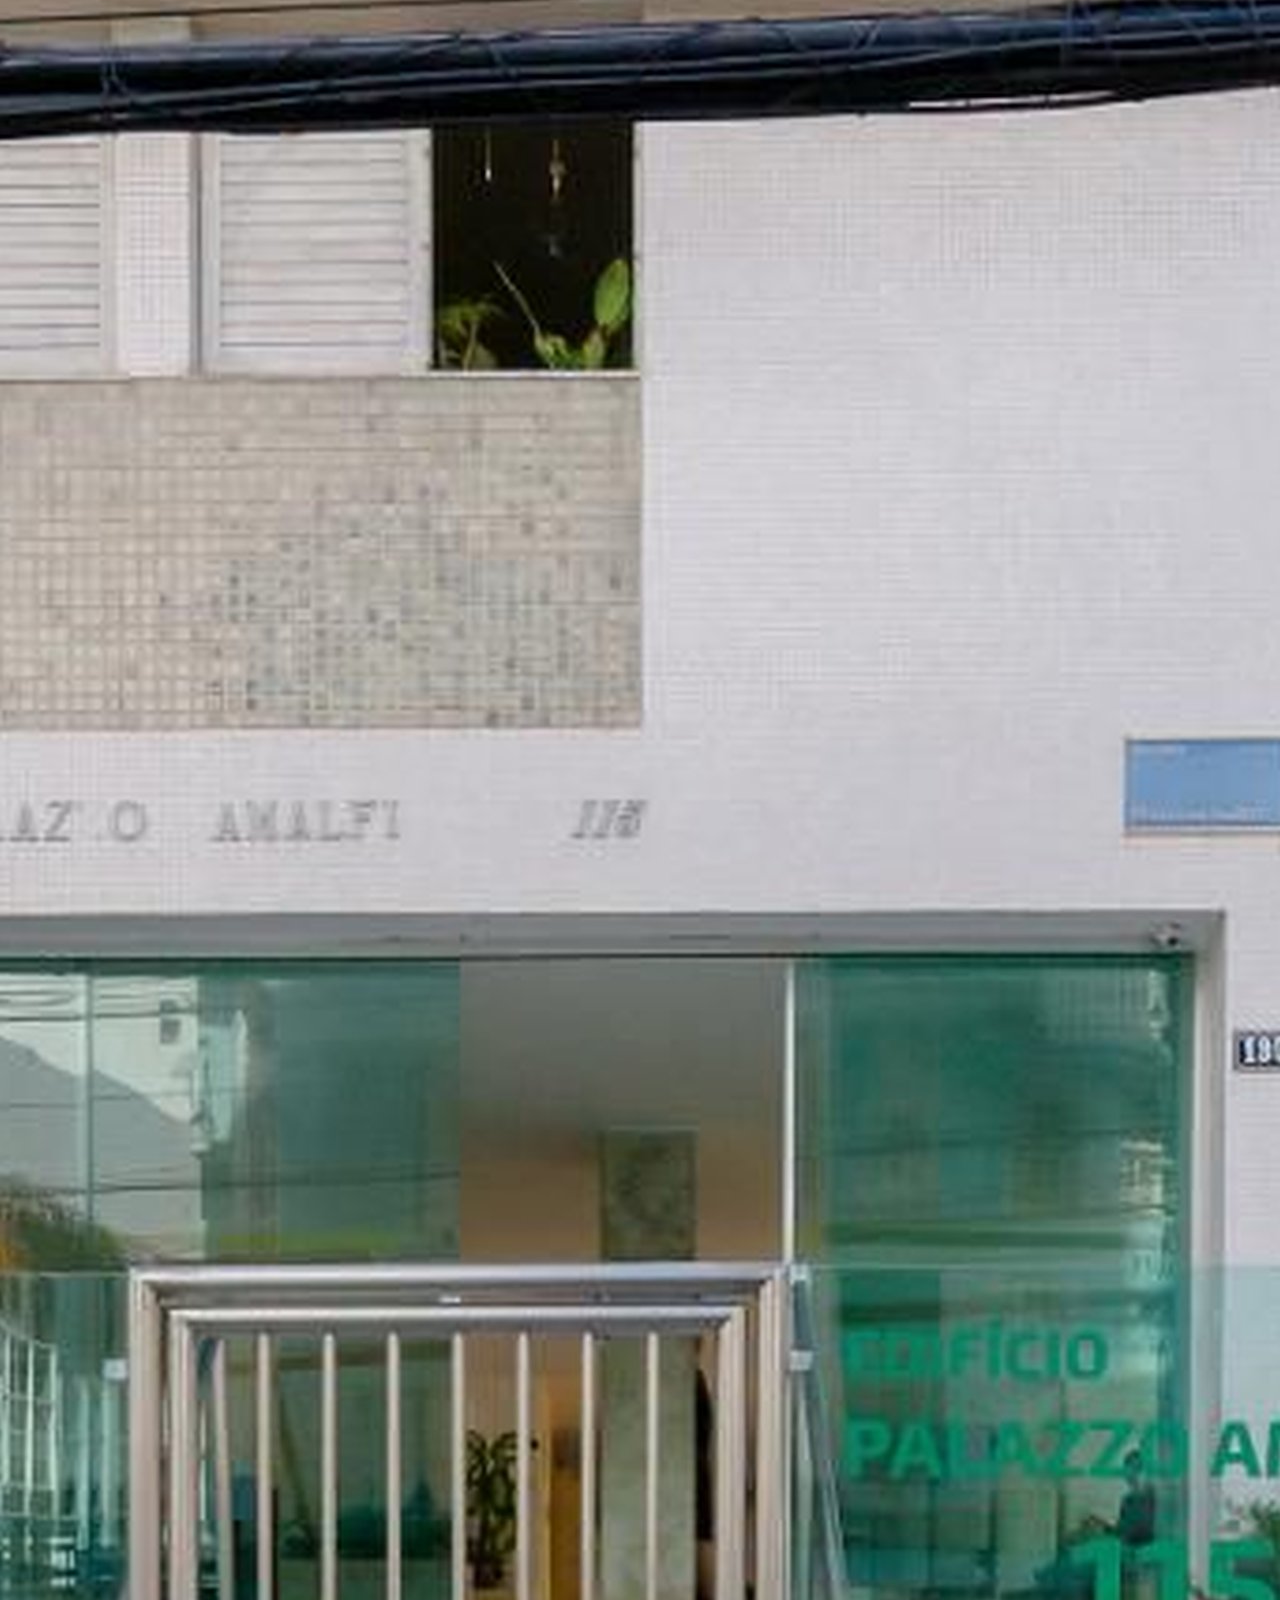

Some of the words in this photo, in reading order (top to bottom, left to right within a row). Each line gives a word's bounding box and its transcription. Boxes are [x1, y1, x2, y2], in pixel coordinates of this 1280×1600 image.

[208, 799, 400, 841] AMALFI
[844, 1313, 1109, 1380] EDIFÍCIO
[845, 1416, 1189, 1480] PALAZZO
